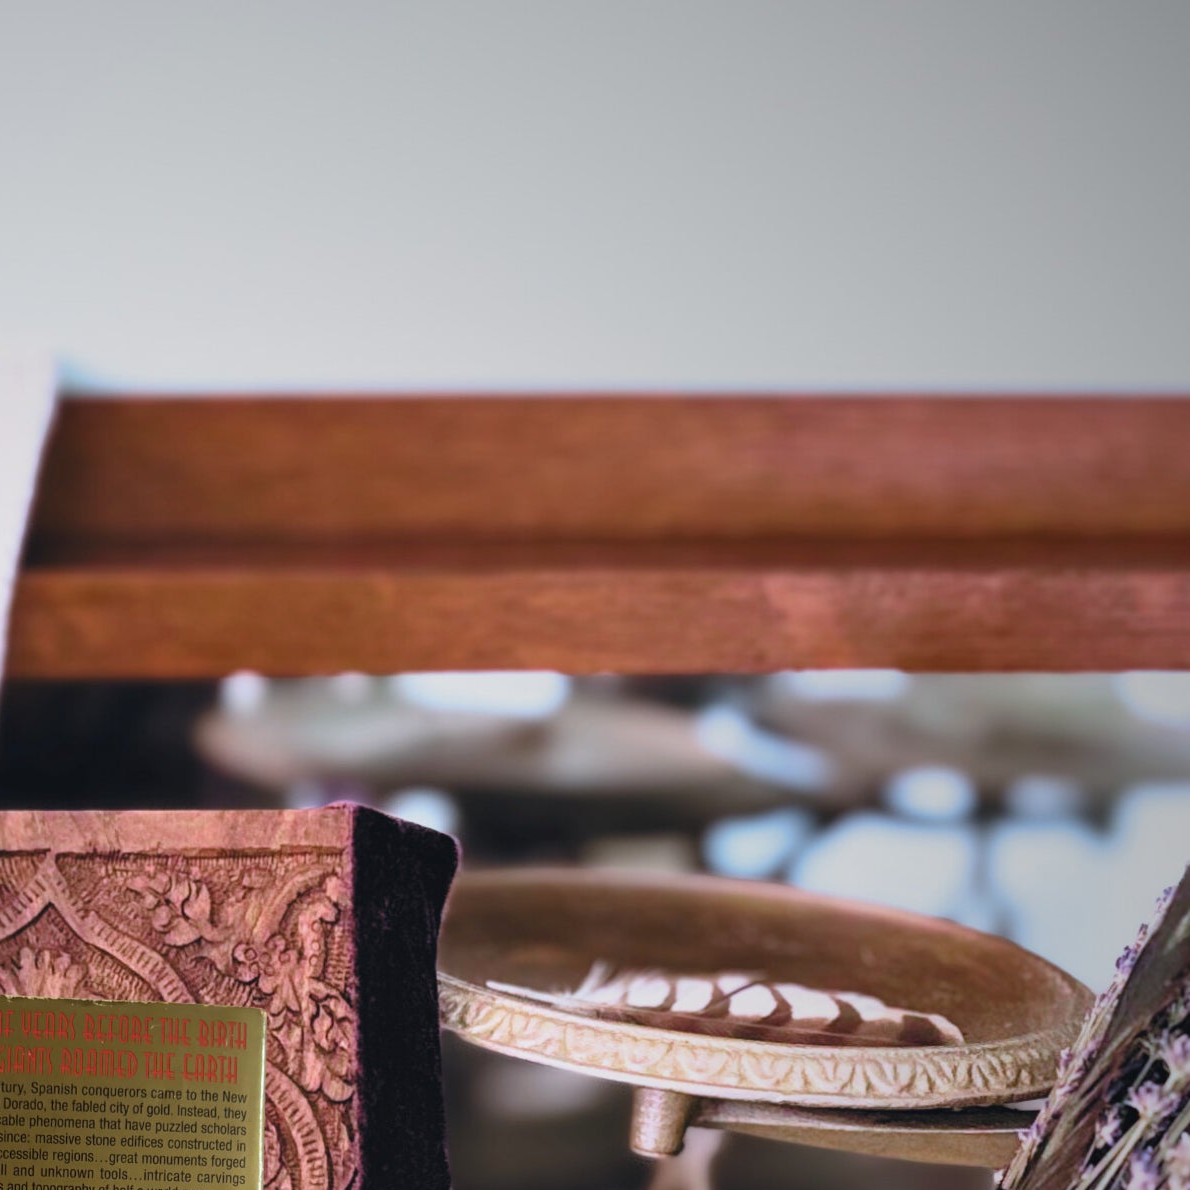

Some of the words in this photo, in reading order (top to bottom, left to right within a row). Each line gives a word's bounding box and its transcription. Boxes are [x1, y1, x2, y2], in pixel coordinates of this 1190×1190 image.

[21, 1011, 75, 1040] YEARS
[82, 1013, 153, 1044] BEFORE
[159, 1017, 190, 1047] THE
[196, 1019, 247, 1049] BIRTH
[59, 1047, 138, 1079] ROAMED
[143, 1051, 175, 1080] THE
[181, 1053, 238, 1084] EARTH
[30, 1081, 78, 1096] Spanish
[81, 1086, 147, 1099] conquerors
[150, 1088, 182, 1100] came
[200, 1089, 219, 1102] the
[222, 1090, 247, 1104] New
[3, 1096, 46, 1112] Dorado,
[71, 1099, 106, 1113] fabled
[109, 1101, 130, 1116] city
[146, 1103, 173, 1118] gold.
[177, 1104, 220, 1120] Instead,
[223, 1106, 247, 1122] they
[29, 1114, 95, 1129] phenomena
[99, 1117, 121, 1130] that
[124, 1117, 152, 1131] have
[155, 1120, 197, 1134] puzzled
[200, 1122, 247, 1136] scholars
[35, 1132, 81, 1145] massive
[85, 1133, 116, 1147] stone
[120, 1134, 164, 1149] edifices
[167, 1137, 232, 1151] constructed
[141, 1154, 208, 1167] monuments
[210, 1154, 246, 1170] forged
[12, 1164, 35, 1177] and
[40, 1165, 94, 1179] unknown
[196, 1171, 246, 1187] carvings
